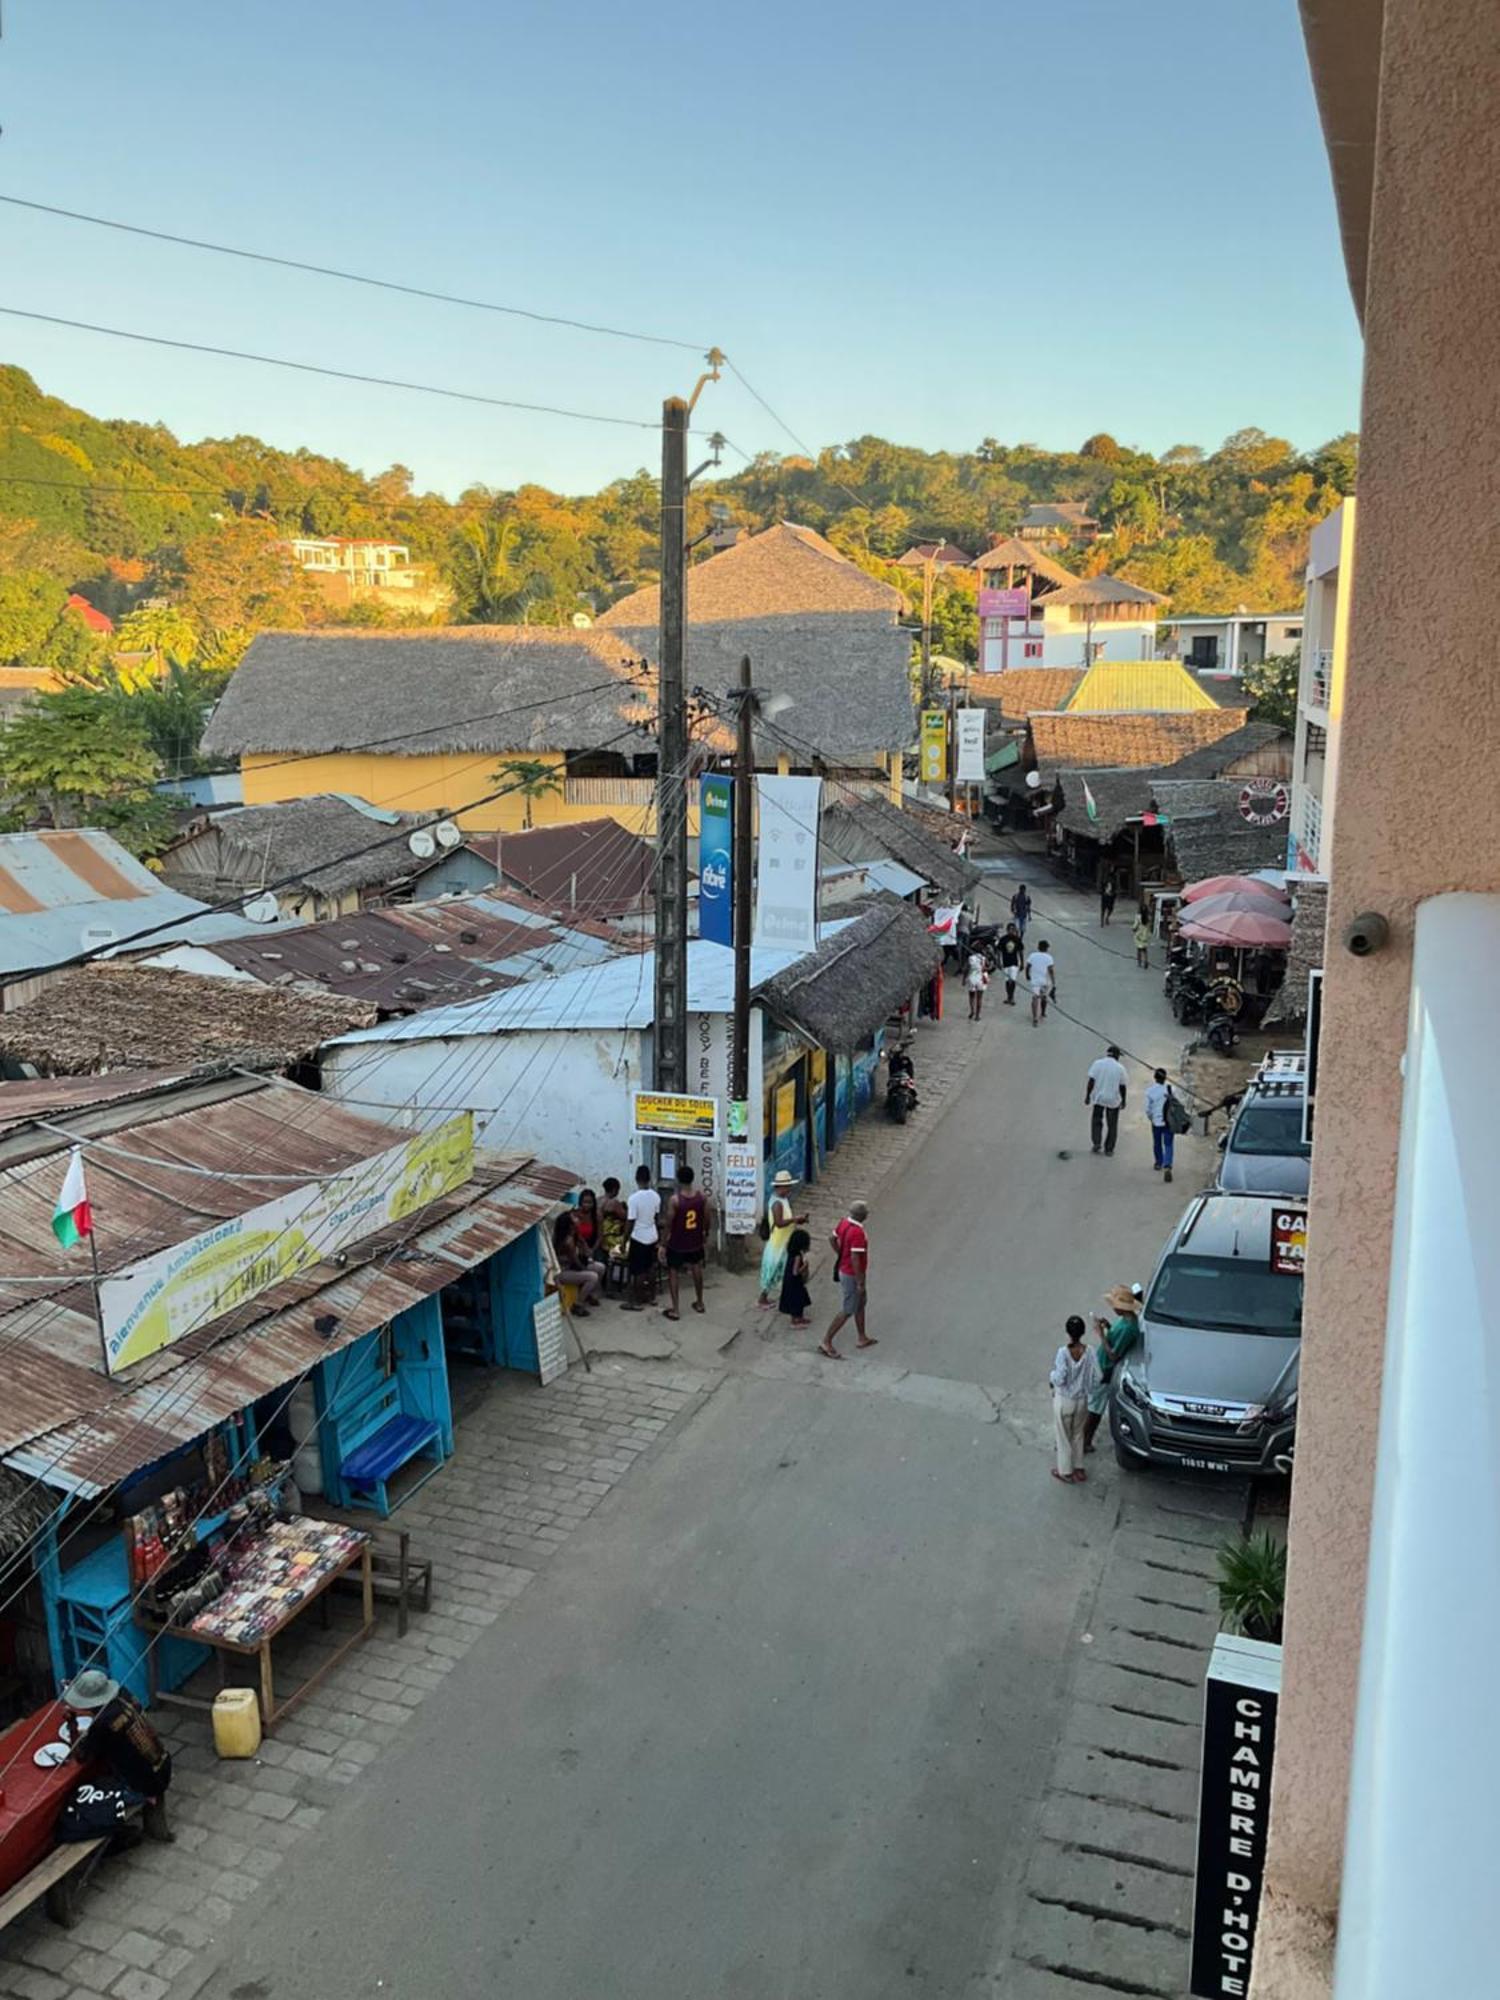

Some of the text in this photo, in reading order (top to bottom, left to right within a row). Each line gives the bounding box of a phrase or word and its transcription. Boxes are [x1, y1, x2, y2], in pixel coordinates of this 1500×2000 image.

[685, 1209, 697, 1230] 2
[109, 1277, 165, 1355] Bienvenue
[1220, 1698, 1262, 1996] CHAMBRE D'HOTE
